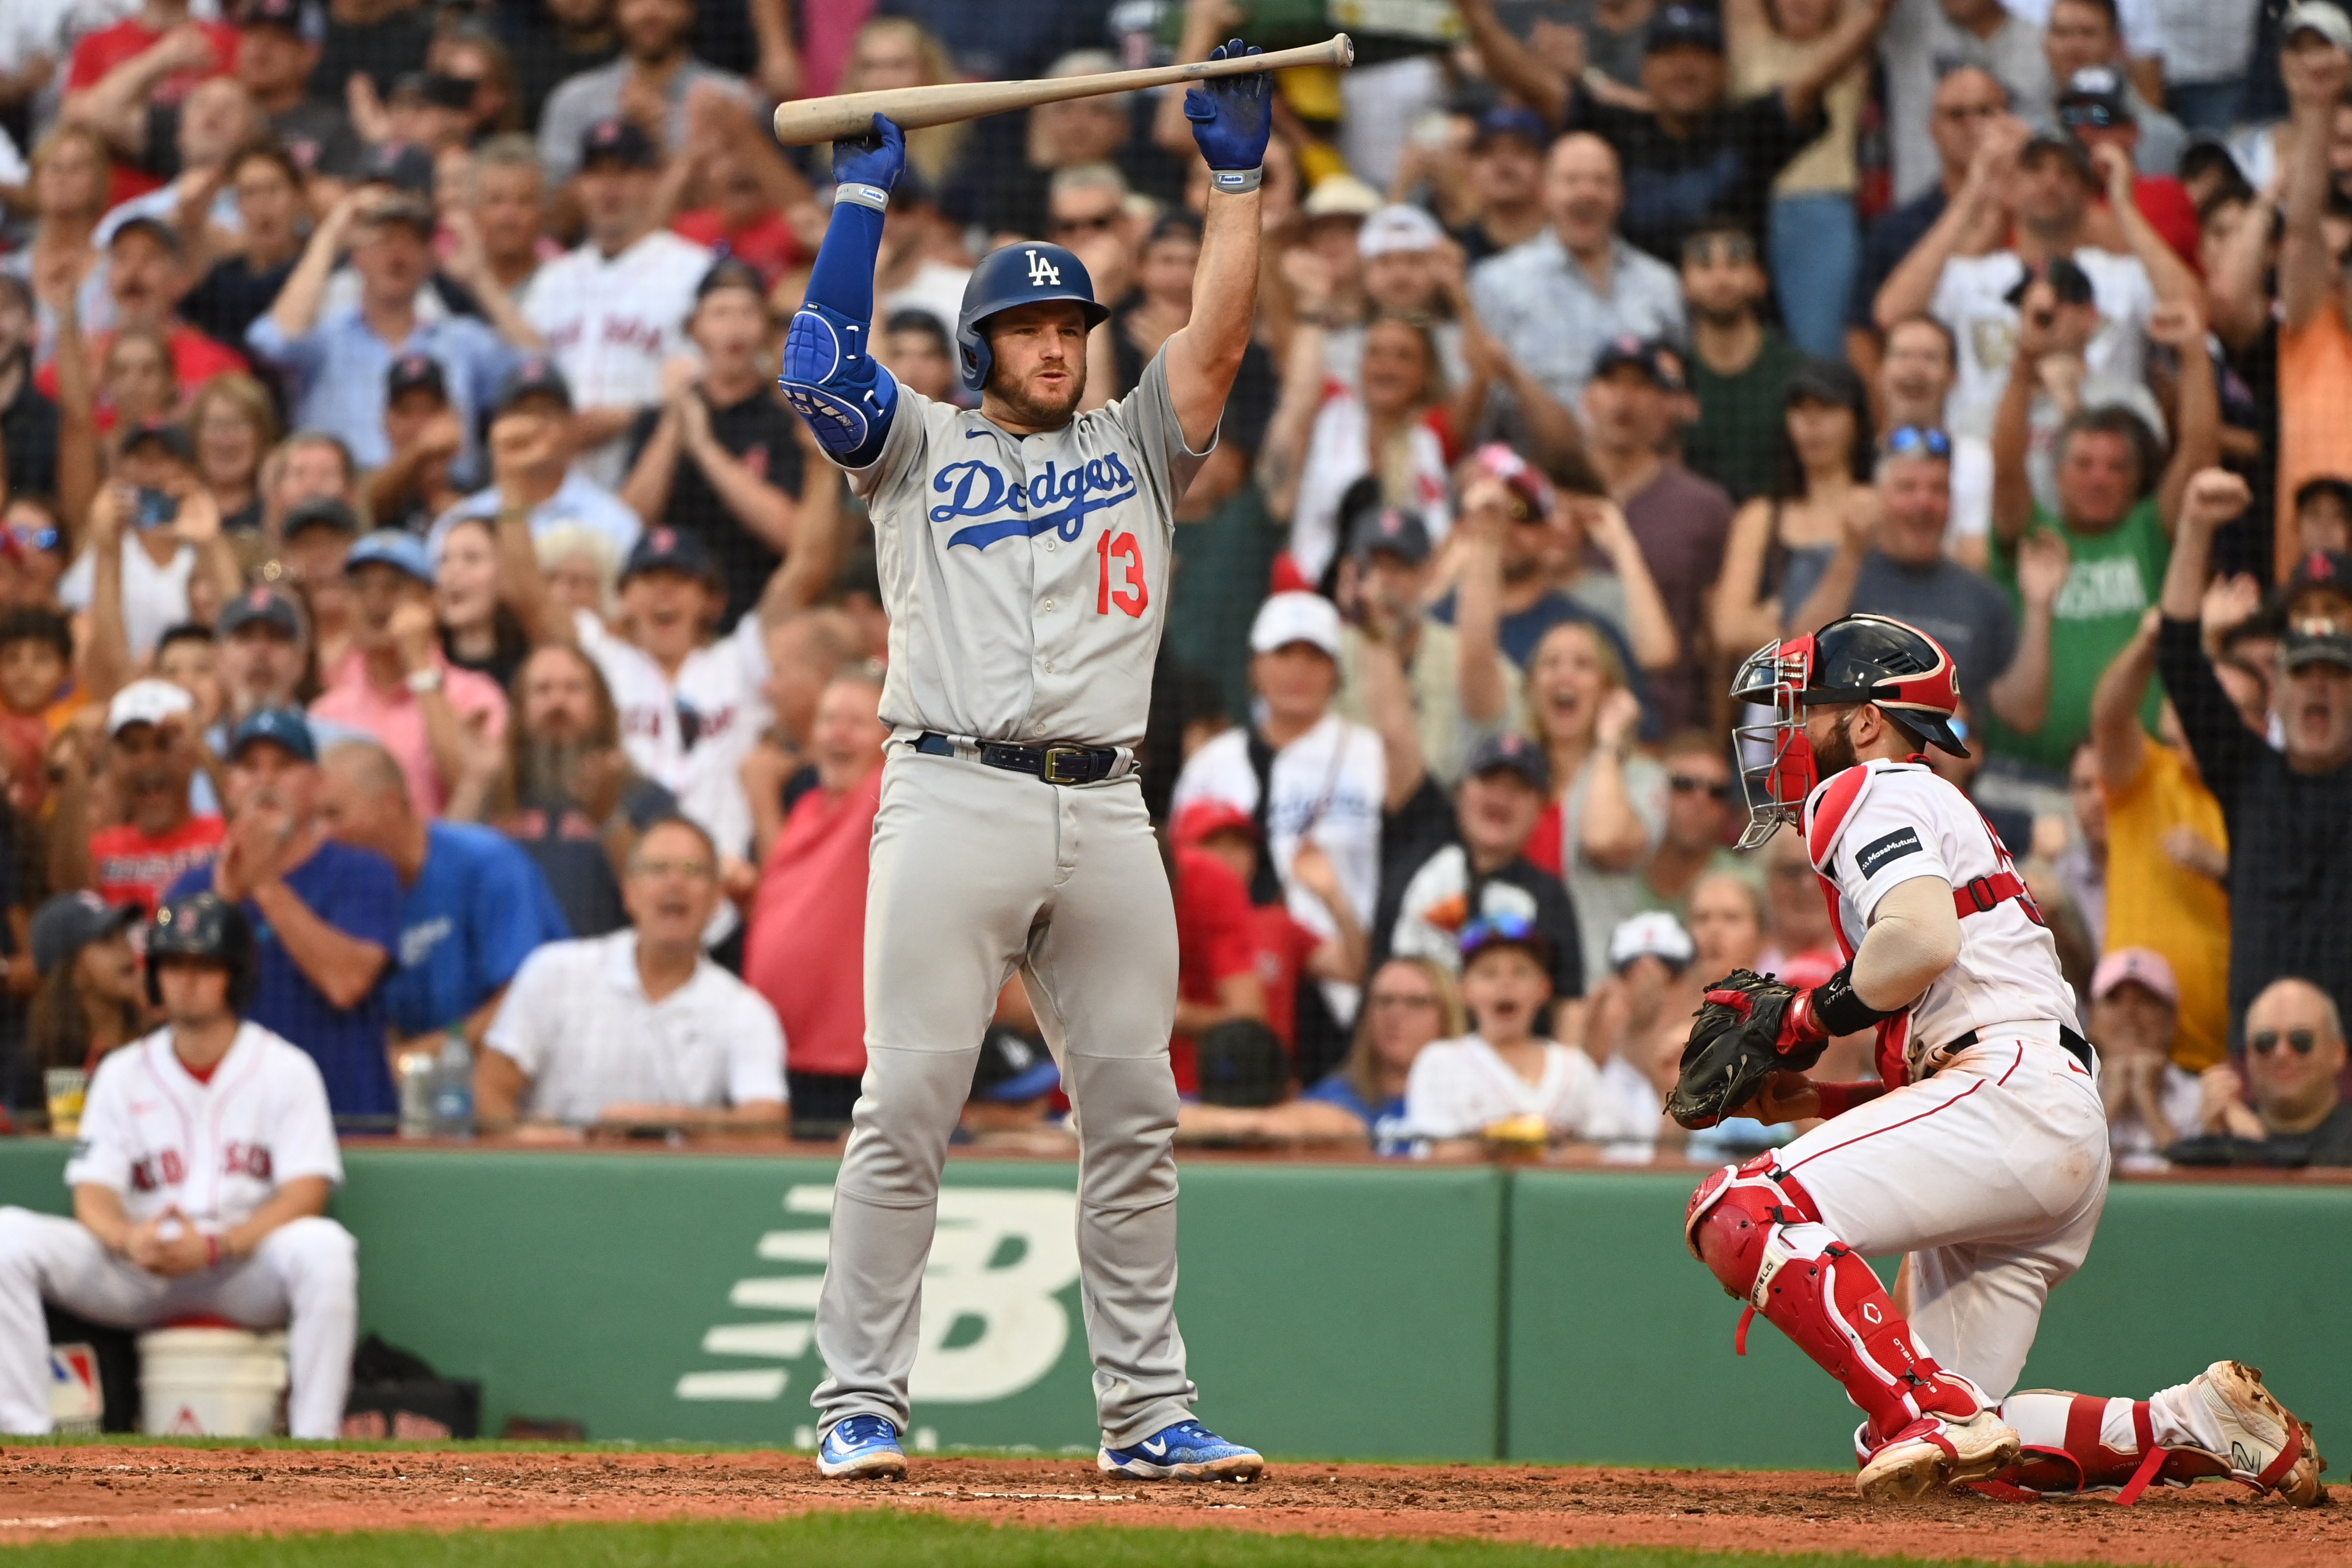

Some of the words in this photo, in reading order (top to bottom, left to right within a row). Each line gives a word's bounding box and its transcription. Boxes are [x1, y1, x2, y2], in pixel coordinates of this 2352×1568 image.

[1025, 249, 1061, 286] LA
[929, 452, 1137, 542] Dodgers
[1097, 529, 1148, 618] 13
[1867, 836, 1918, 863] MassMutual
